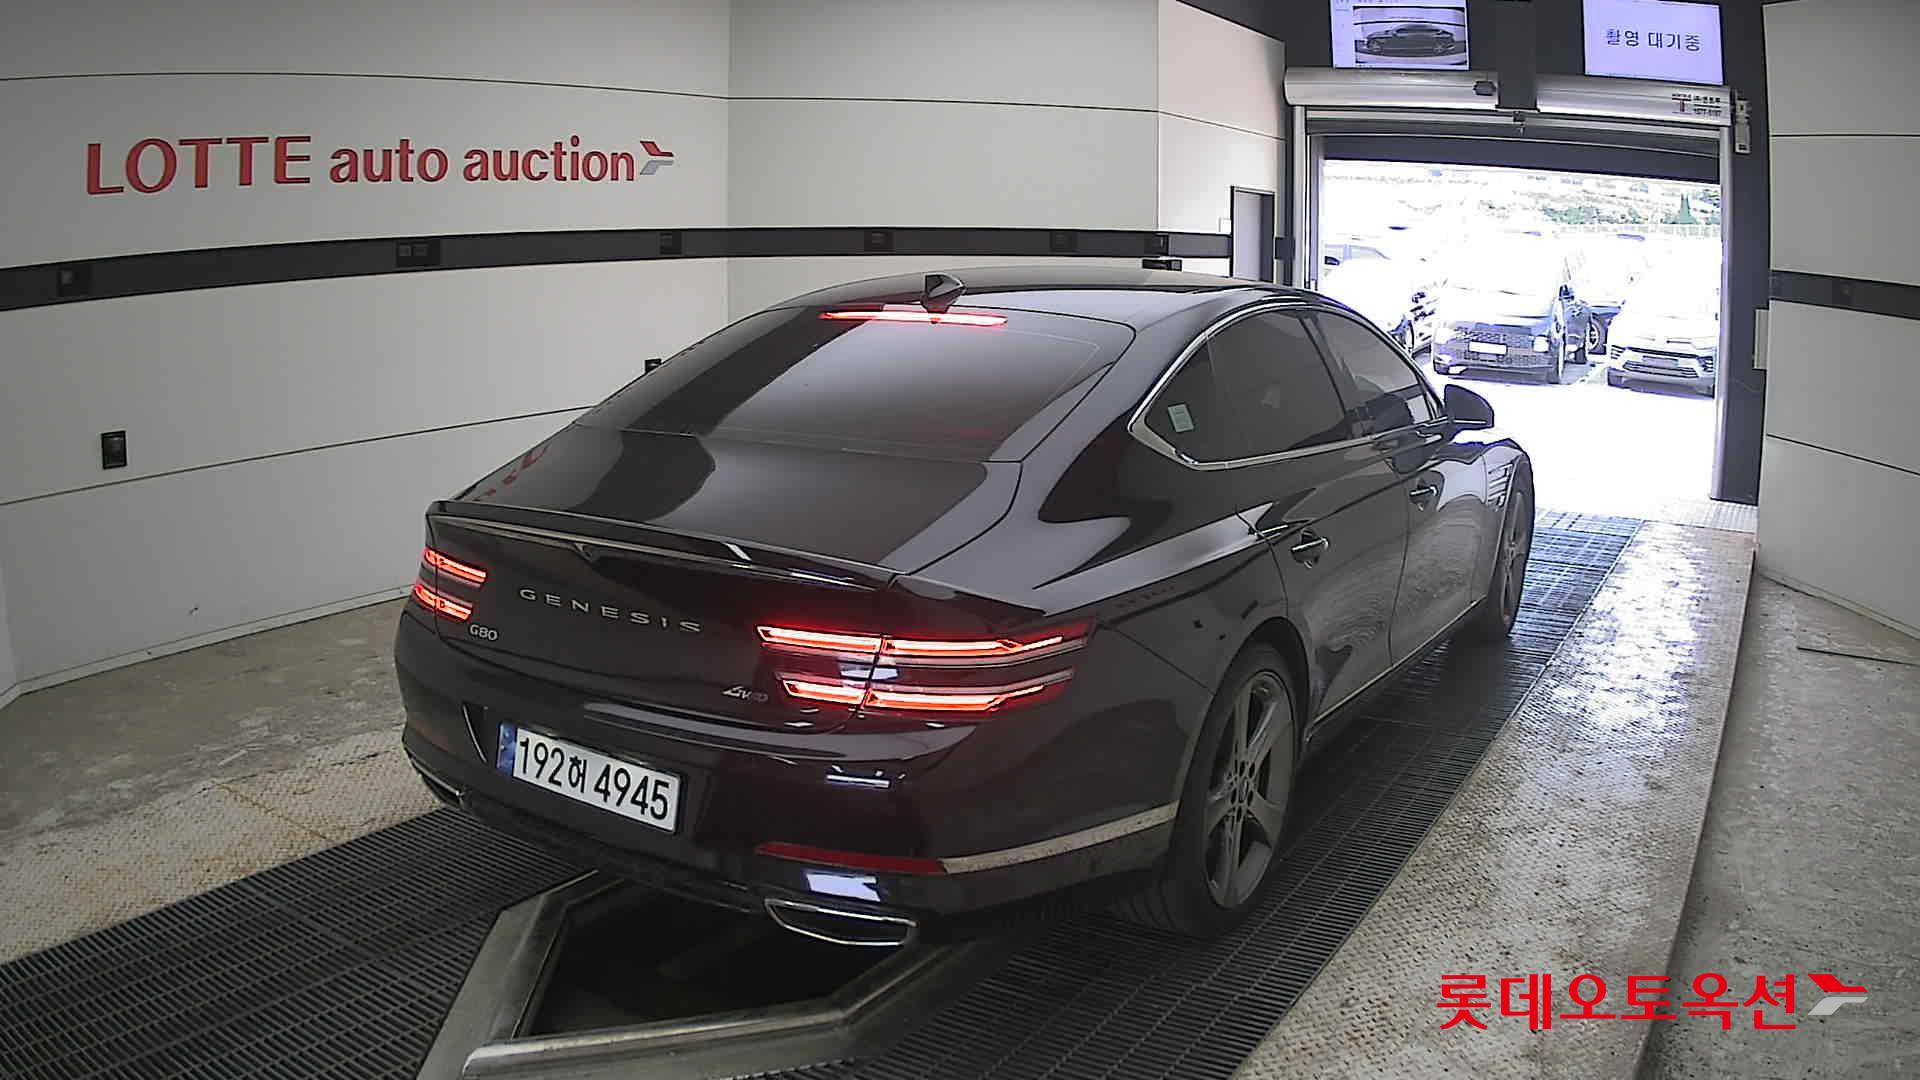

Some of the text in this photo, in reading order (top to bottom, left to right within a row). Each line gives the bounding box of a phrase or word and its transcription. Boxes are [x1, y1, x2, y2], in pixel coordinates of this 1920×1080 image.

[1648, 31, 1701, 52] 대기중
[86, 135, 634, 195] LOTTE auto auction
[469, 624, 498, 642] G80
[519, 588, 702, 633] GENESIS
[519, 737, 670, 821] 192허 4945
